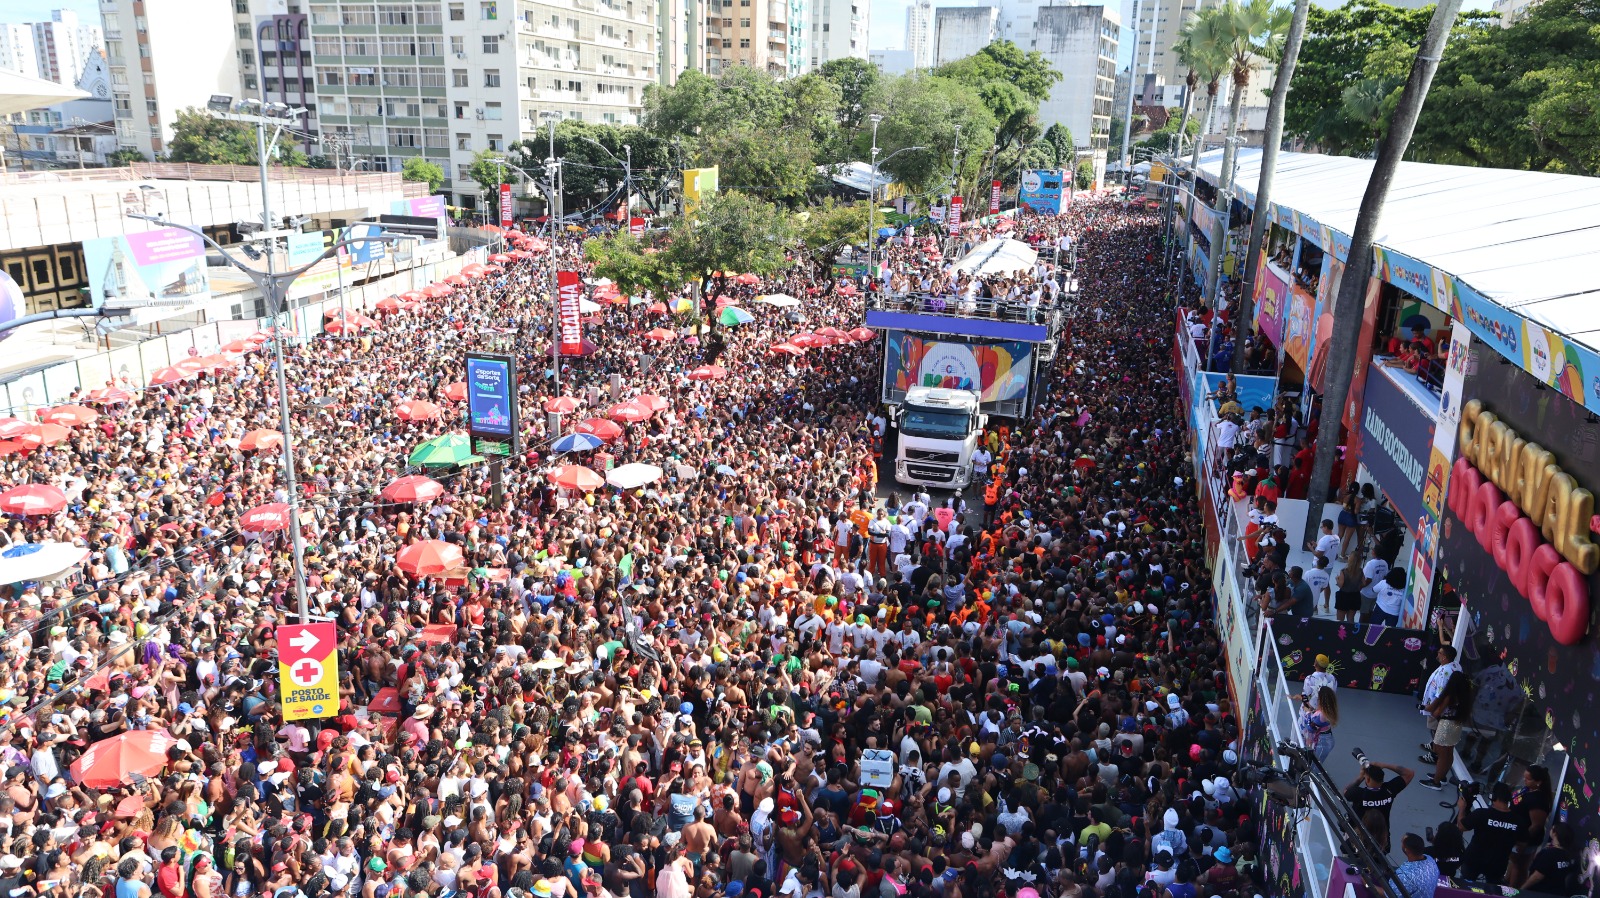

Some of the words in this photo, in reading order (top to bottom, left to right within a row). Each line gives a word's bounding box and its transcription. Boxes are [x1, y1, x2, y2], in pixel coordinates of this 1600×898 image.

[501, 191, 512, 221] BRAHMA
[991, 186, 1001, 210] BRAHMA
[950, 203, 961, 234] BRAHMA
[560, 283, 580, 344] BRAHMA
[1364, 406, 1386, 446] RÁDIO
[1383, 427, 1424, 493] SOCIEDADE
[1460, 398, 1600, 575] CARNAVAL
[291, 688, 324, 696] POSTO
[1362, 797, 1392, 807] EQUIPE
[1487, 818, 1518, 831] EQUIPE
